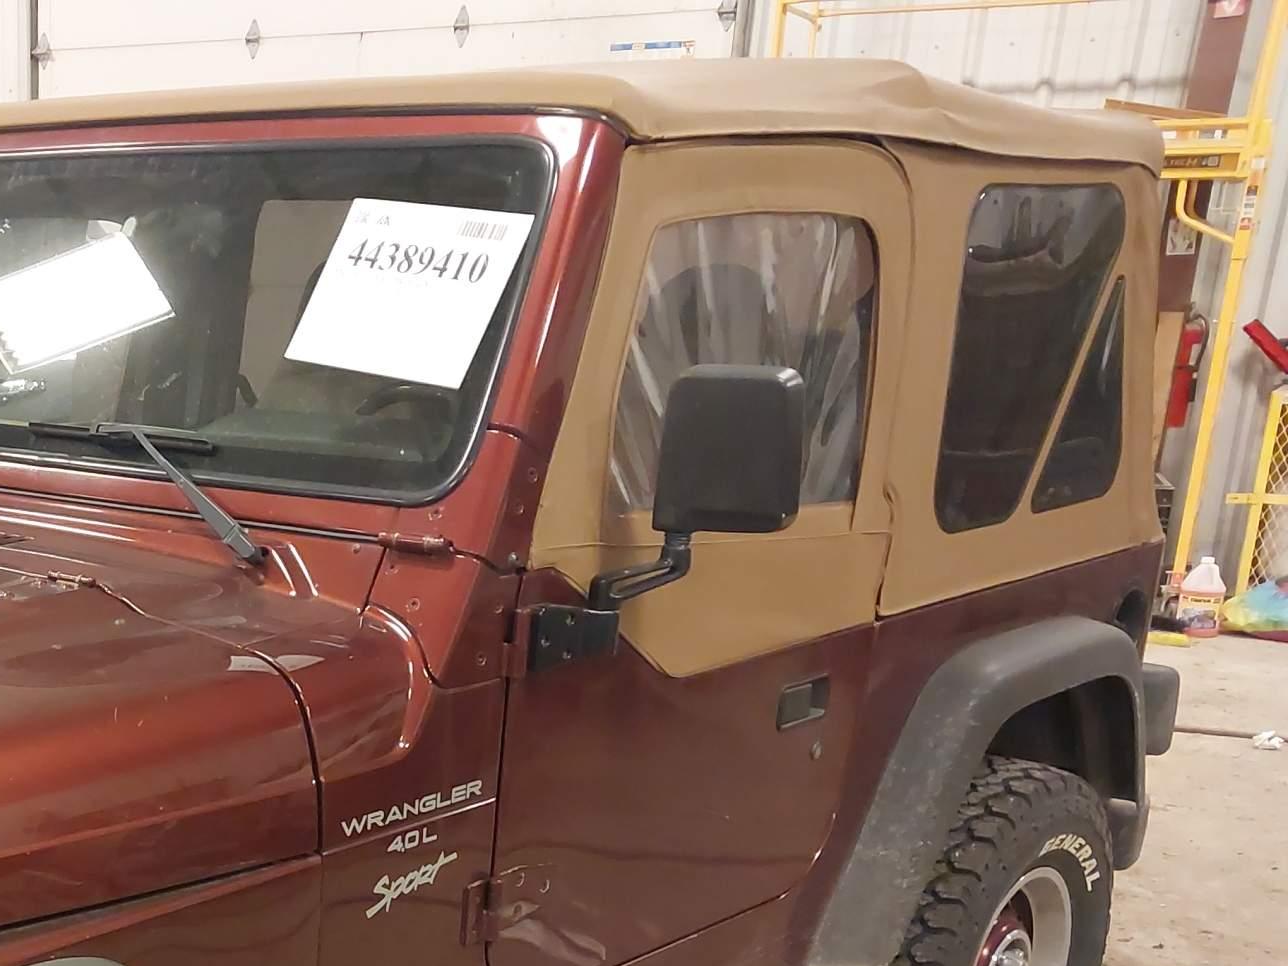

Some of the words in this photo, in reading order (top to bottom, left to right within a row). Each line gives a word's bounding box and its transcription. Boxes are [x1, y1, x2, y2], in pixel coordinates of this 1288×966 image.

[348, 238, 489, 283] 44389410
[341, 780, 482, 837] WRANGLER
[1038, 834, 1100, 891] GENERAL
